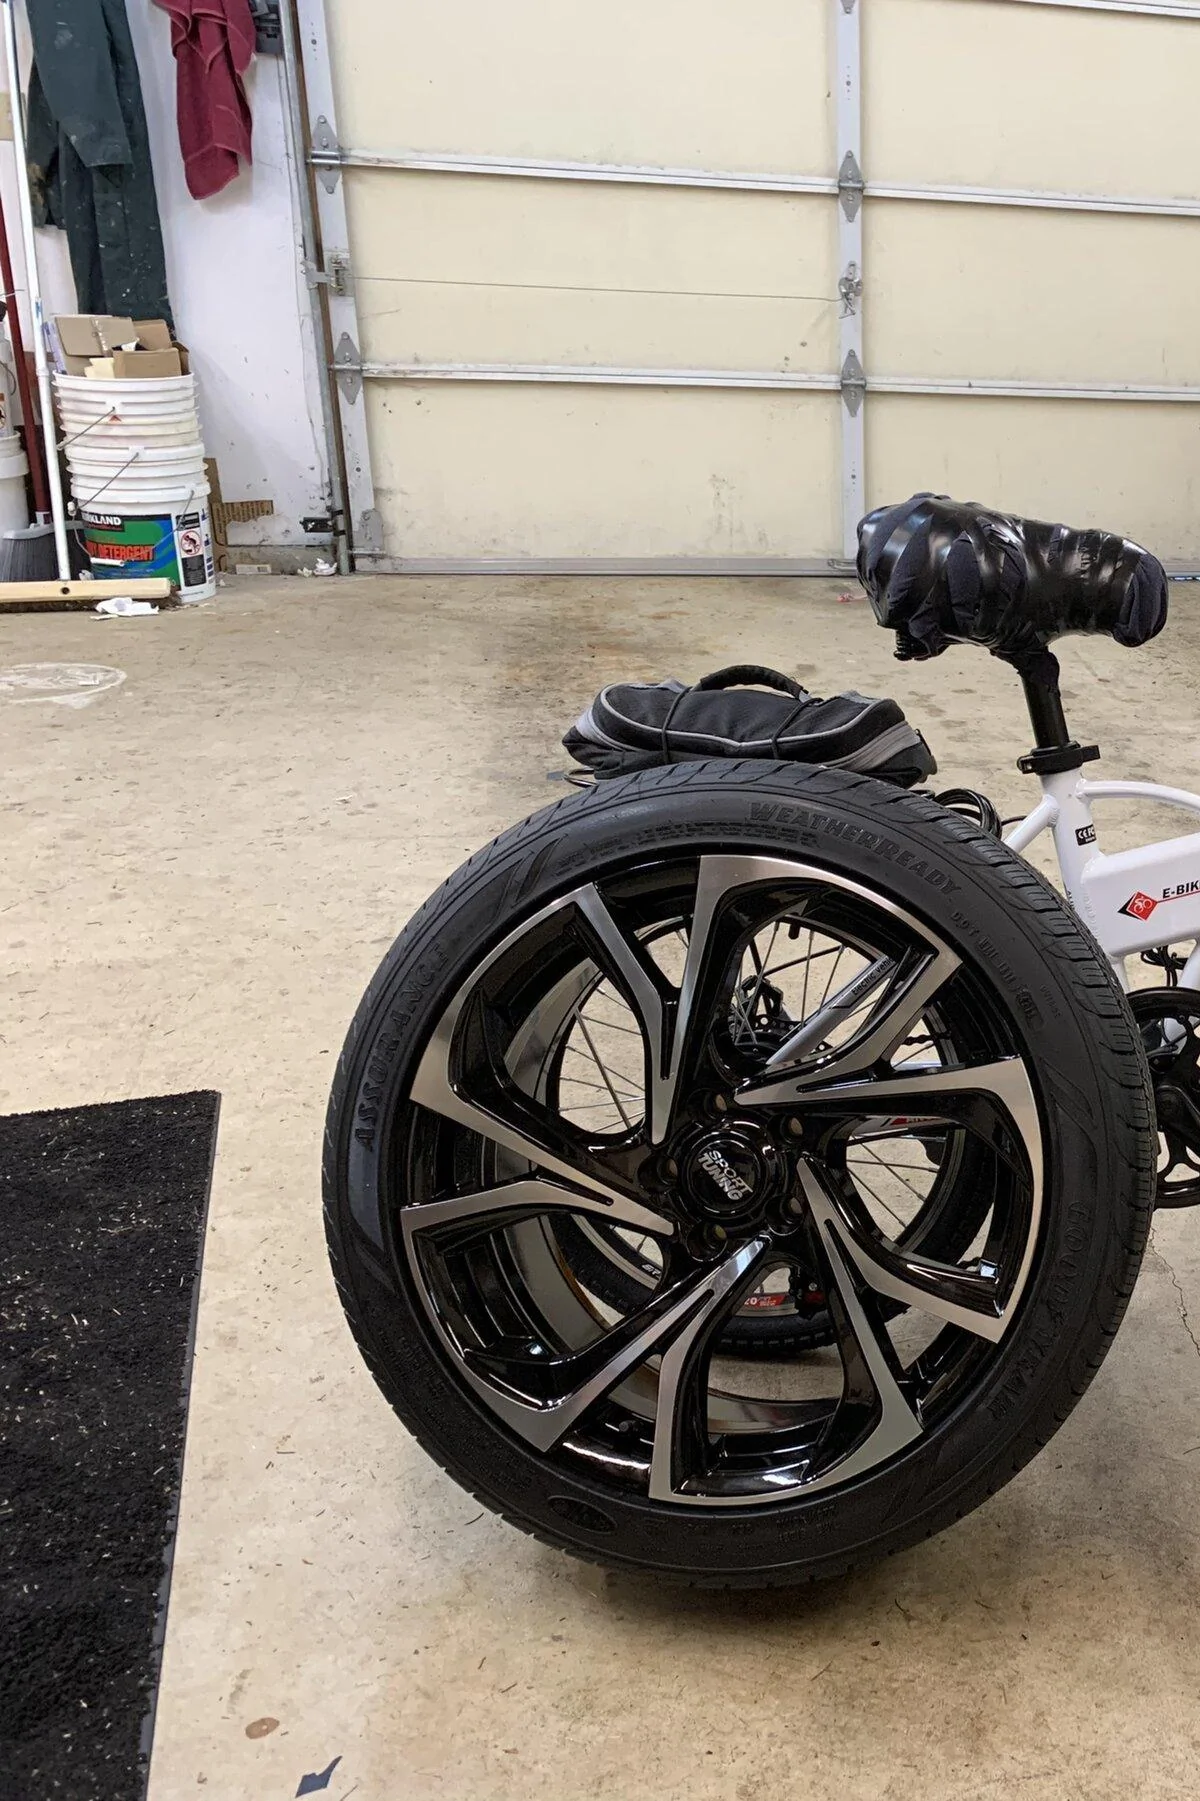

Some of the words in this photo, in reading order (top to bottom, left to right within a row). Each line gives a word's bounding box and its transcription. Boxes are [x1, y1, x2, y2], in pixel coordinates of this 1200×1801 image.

[98, 543, 154, 561] DETERGENT
[355, 943, 449, 1153] ASSURANCE
[698, 1152, 743, 1201] TUNING
[708, 1150, 754, 1193] SPORT
[987, 1201, 1090, 1420] GOODYEAR
